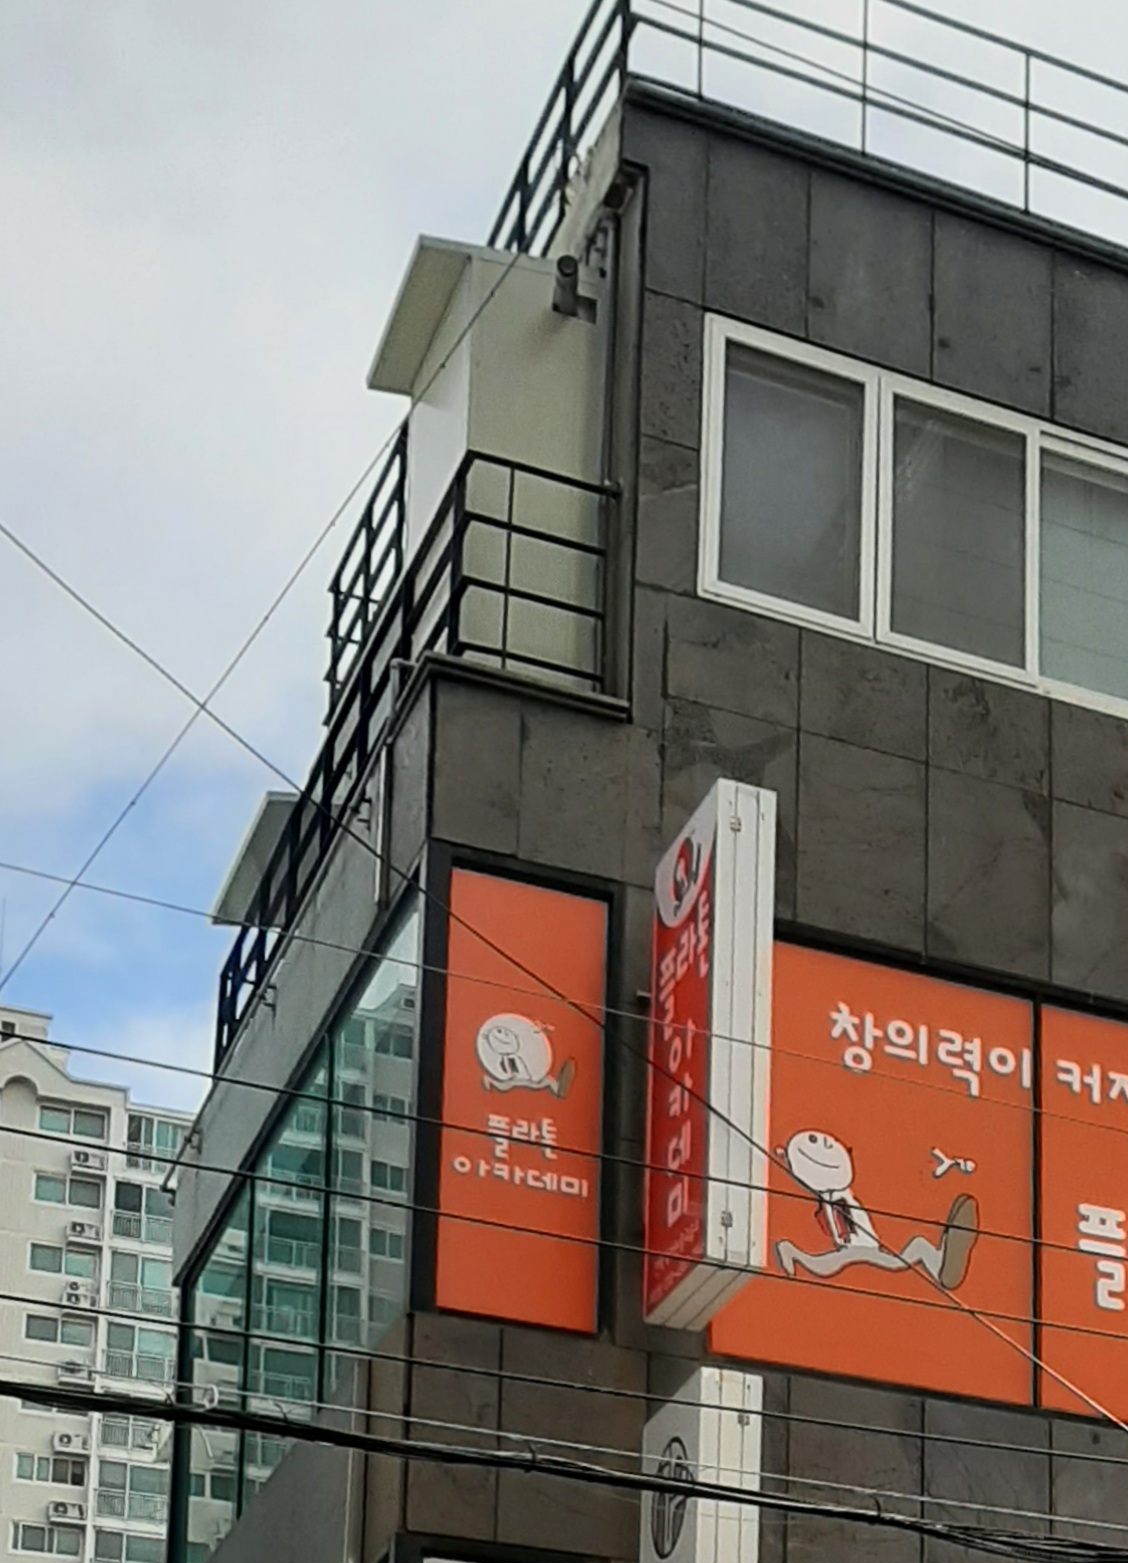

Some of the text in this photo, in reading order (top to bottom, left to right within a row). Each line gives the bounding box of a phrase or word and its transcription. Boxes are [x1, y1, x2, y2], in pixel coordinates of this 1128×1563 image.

[829, 1001, 1033, 1098] 창의력이
[487, 1113, 558, 1160] 플라톤
[452, 1157, 589, 1198] 아카데미
